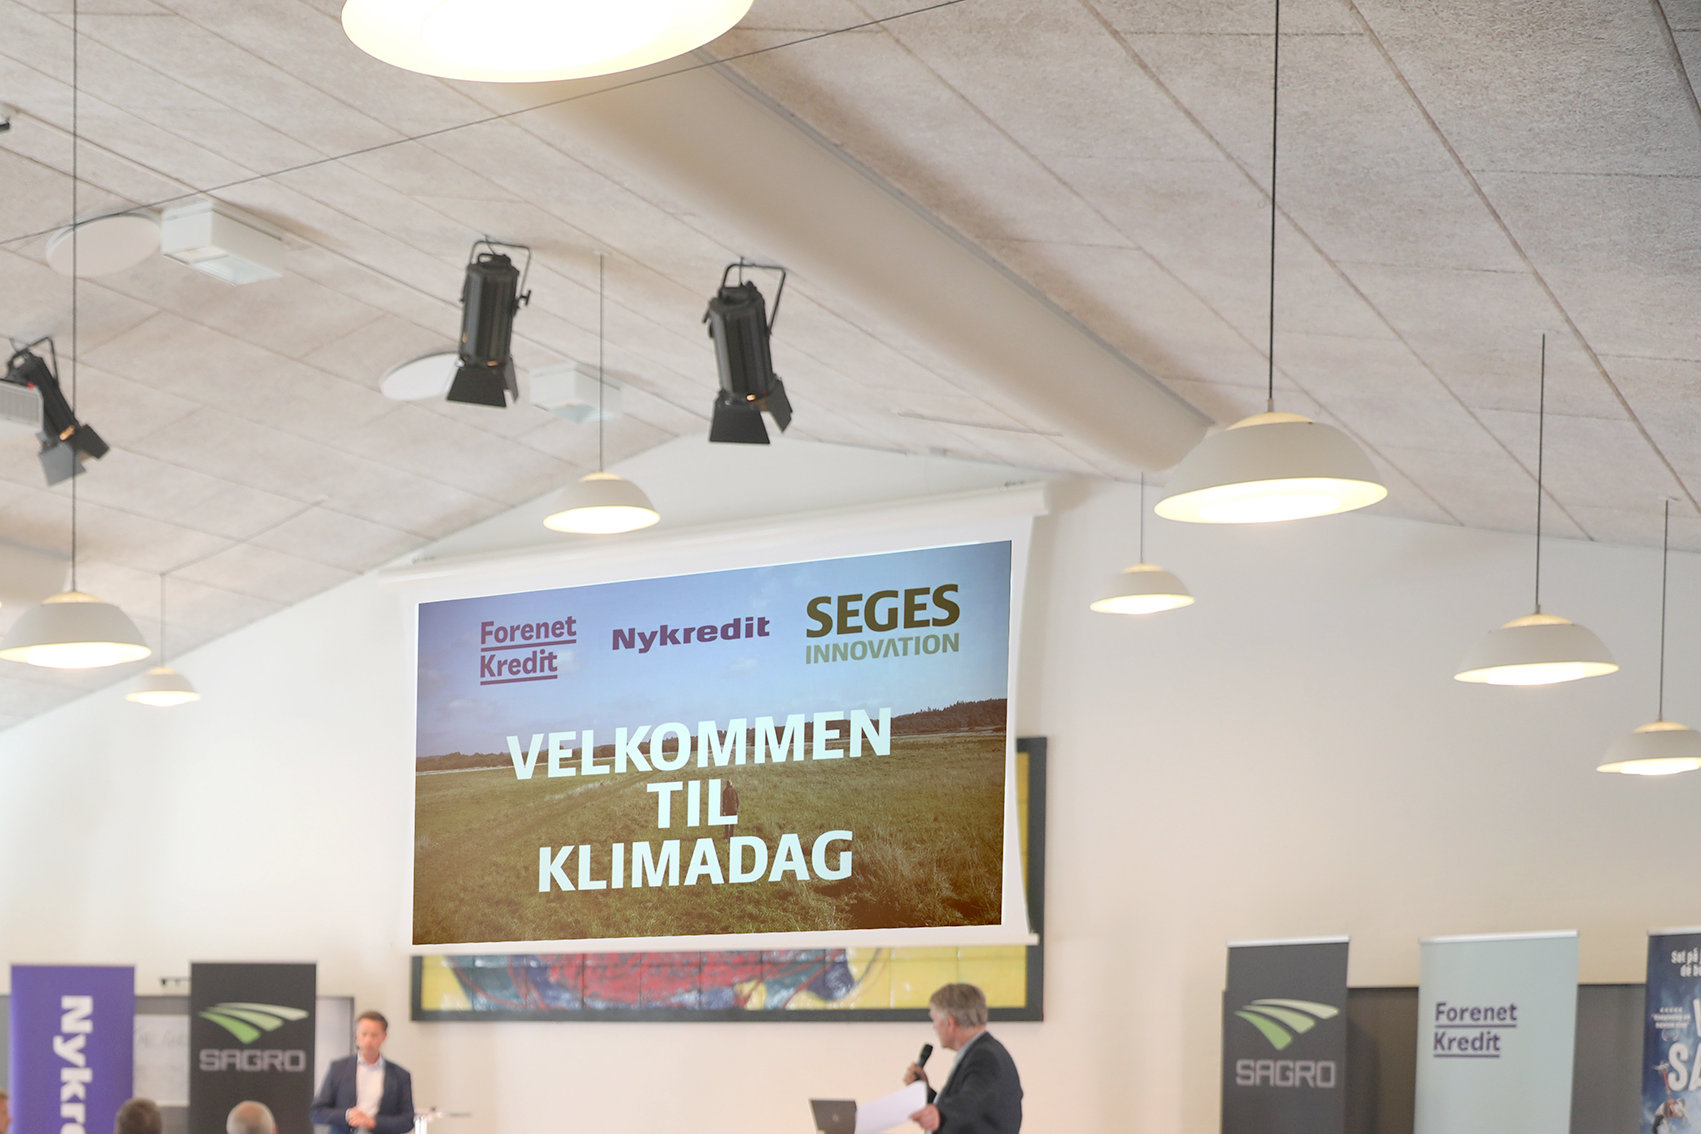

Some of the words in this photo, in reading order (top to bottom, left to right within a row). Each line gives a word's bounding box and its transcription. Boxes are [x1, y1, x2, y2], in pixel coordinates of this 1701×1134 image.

[807, 584, 960, 638] SEGES
[481, 616, 577, 645] Forenet
[612, 616, 770, 654] Nykredit
[480, 648, 558, 679] Kredit
[806, 633, 960, 665] INNOVATION
[507, 707, 891, 780] VELKOMMEN
[647, 778, 738, 829] TIL
[538, 830, 853, 892] KLIMADAG
[1435, 1002, 1517, 1021] Forenet
[1433, 1031, 1500, 1051] Kredit
[199, 1048, 307, 1072] SAGRO
[1236, 1058, 1335, 1089] SAGRO
